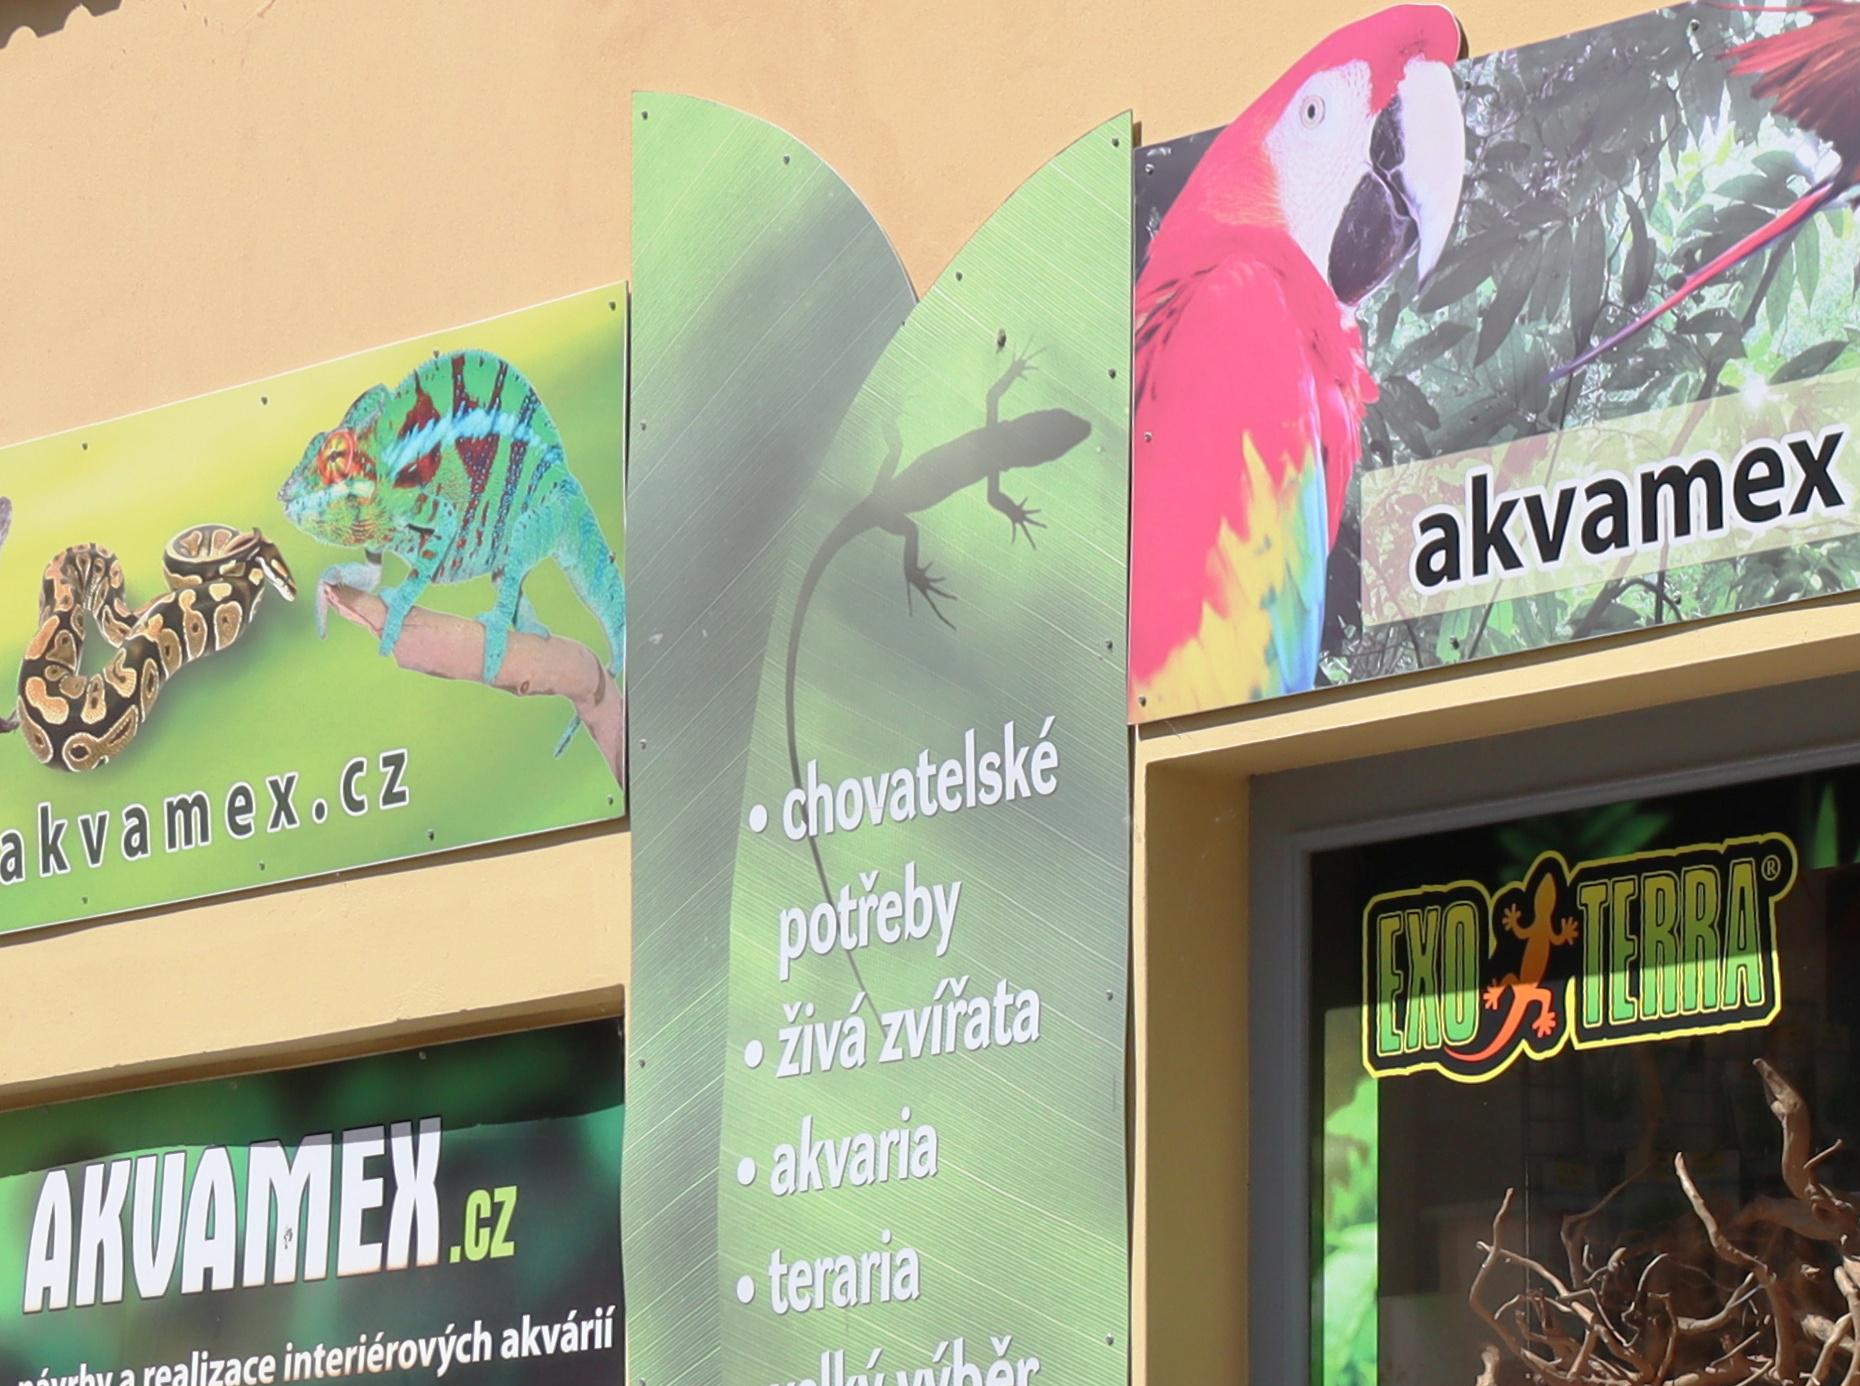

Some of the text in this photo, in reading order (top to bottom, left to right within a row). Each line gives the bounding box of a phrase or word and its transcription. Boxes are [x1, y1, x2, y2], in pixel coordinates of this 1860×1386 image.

[1414, 428, 1846, 588] akvamex
[0, 748, 409, 885] akvamex.cz
[783, 716, 1059, 840] chovatelské
[778, 862, 962, 981] potřeby
[1376, 900, 1481, 1057] EXO
[776, 975, 1041, 1078] živá zvířata
[770, 1106, 939, 1196] akvaria
[768, 1228, 920, 1315] teraria
[283, 1321, 492, 1383] interiérových
[500, 1305, 617, 1359] akvárií
